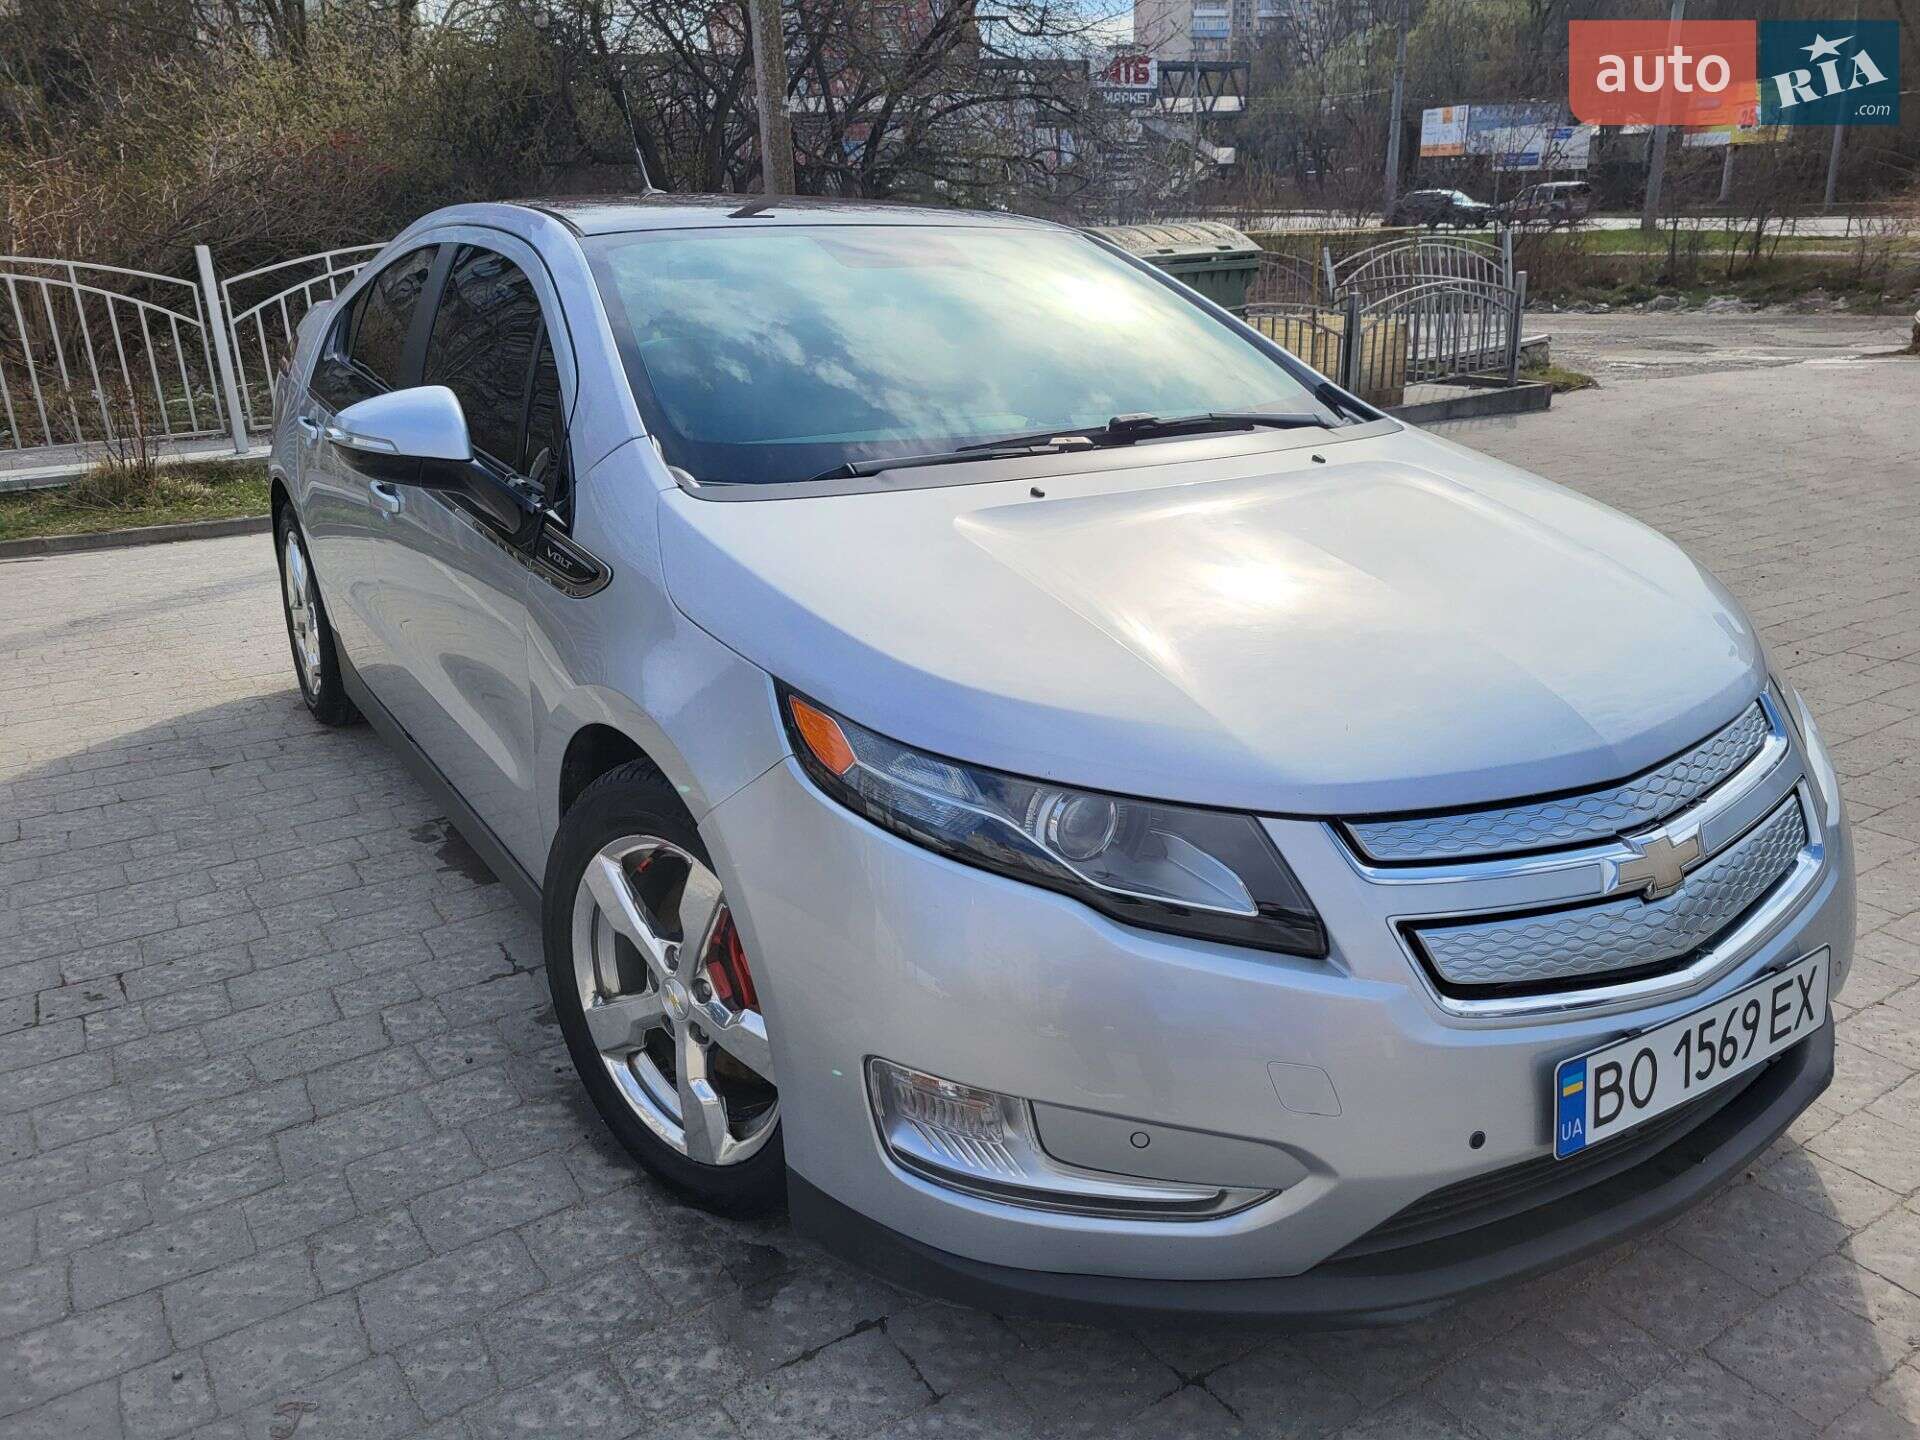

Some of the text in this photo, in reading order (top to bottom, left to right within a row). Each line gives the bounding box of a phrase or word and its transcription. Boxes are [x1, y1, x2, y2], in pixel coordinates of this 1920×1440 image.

[1103, 92, 1152, 104] МАРКЕТ
[546, 545, 573, 569] VOLT
[1593, 965, 1817, 1129] BO 1569 EX
[1561, 1117, 1583, 1141] UA
